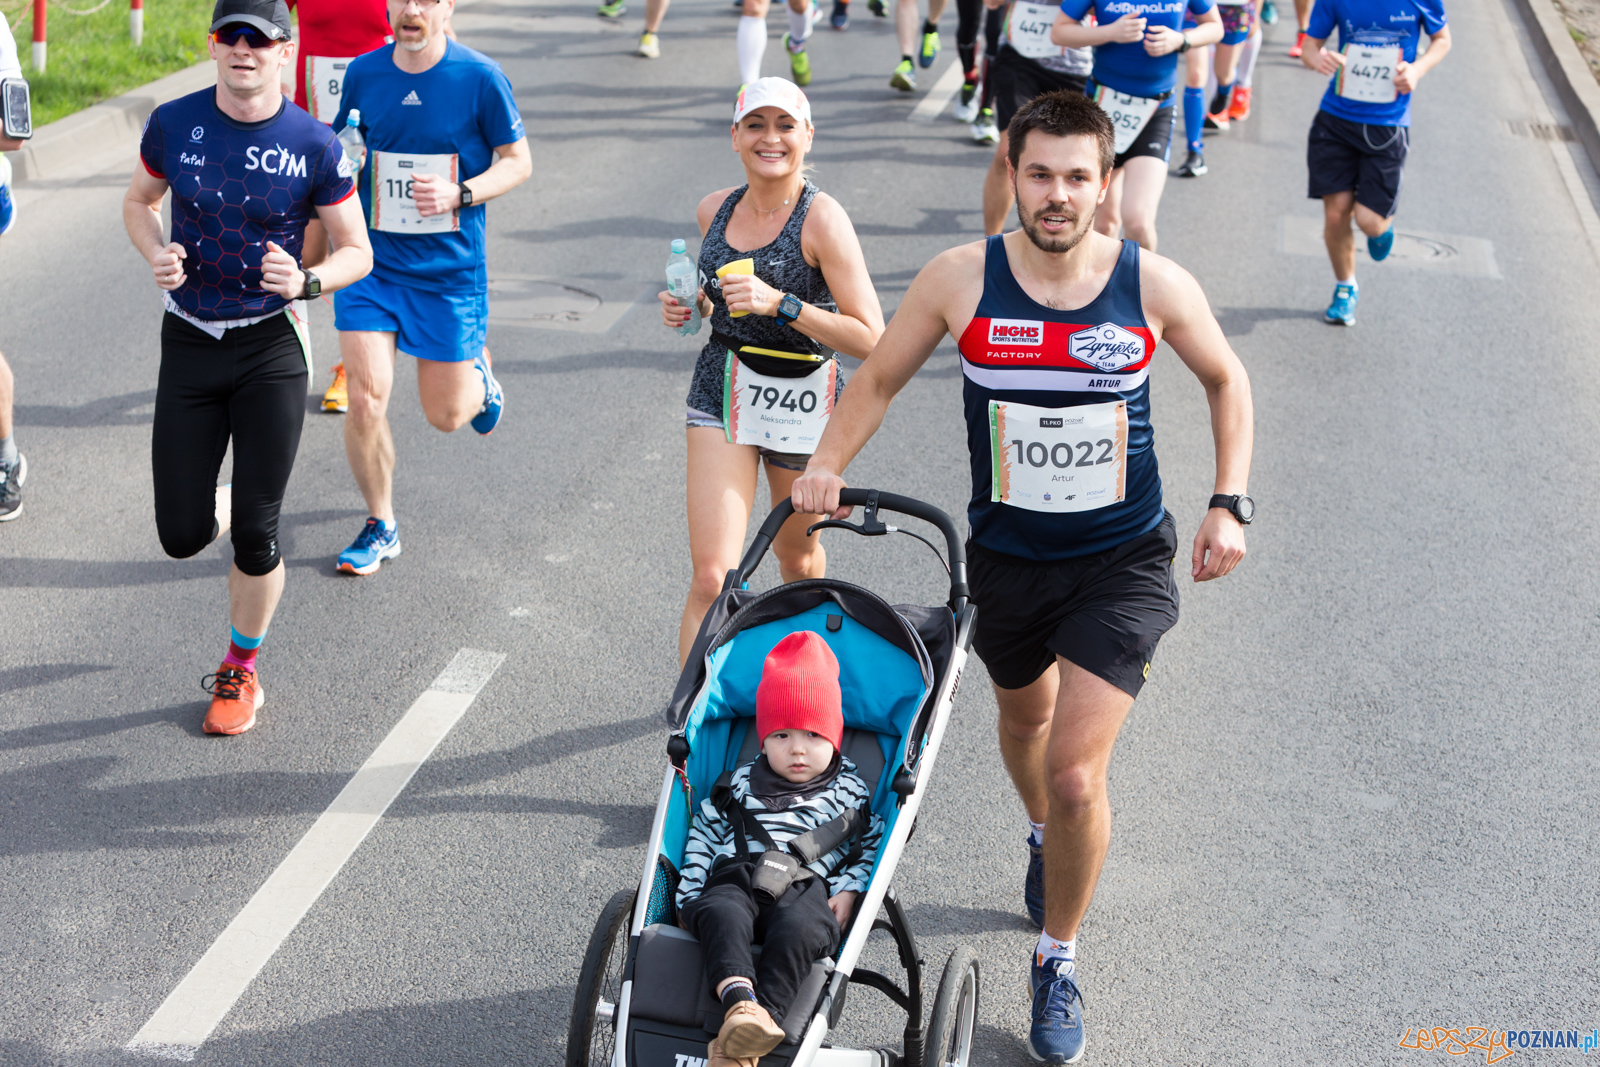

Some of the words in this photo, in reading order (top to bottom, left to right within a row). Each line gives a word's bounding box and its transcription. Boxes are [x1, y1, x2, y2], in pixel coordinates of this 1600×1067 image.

[1351, 64, 1391, 80] 4472
[993, 325, 1039, 338] HIGH5
[986, 351, 1042, 359] FACTORY
[1088, 379, 1121, 388] ARTUR
[748, 384, 817, 414] 7940
[760, 414, 802, 425] Aleksandra
[1011, 438, 1113, 469] 10022
[764, 859, 789, 872] THULE
